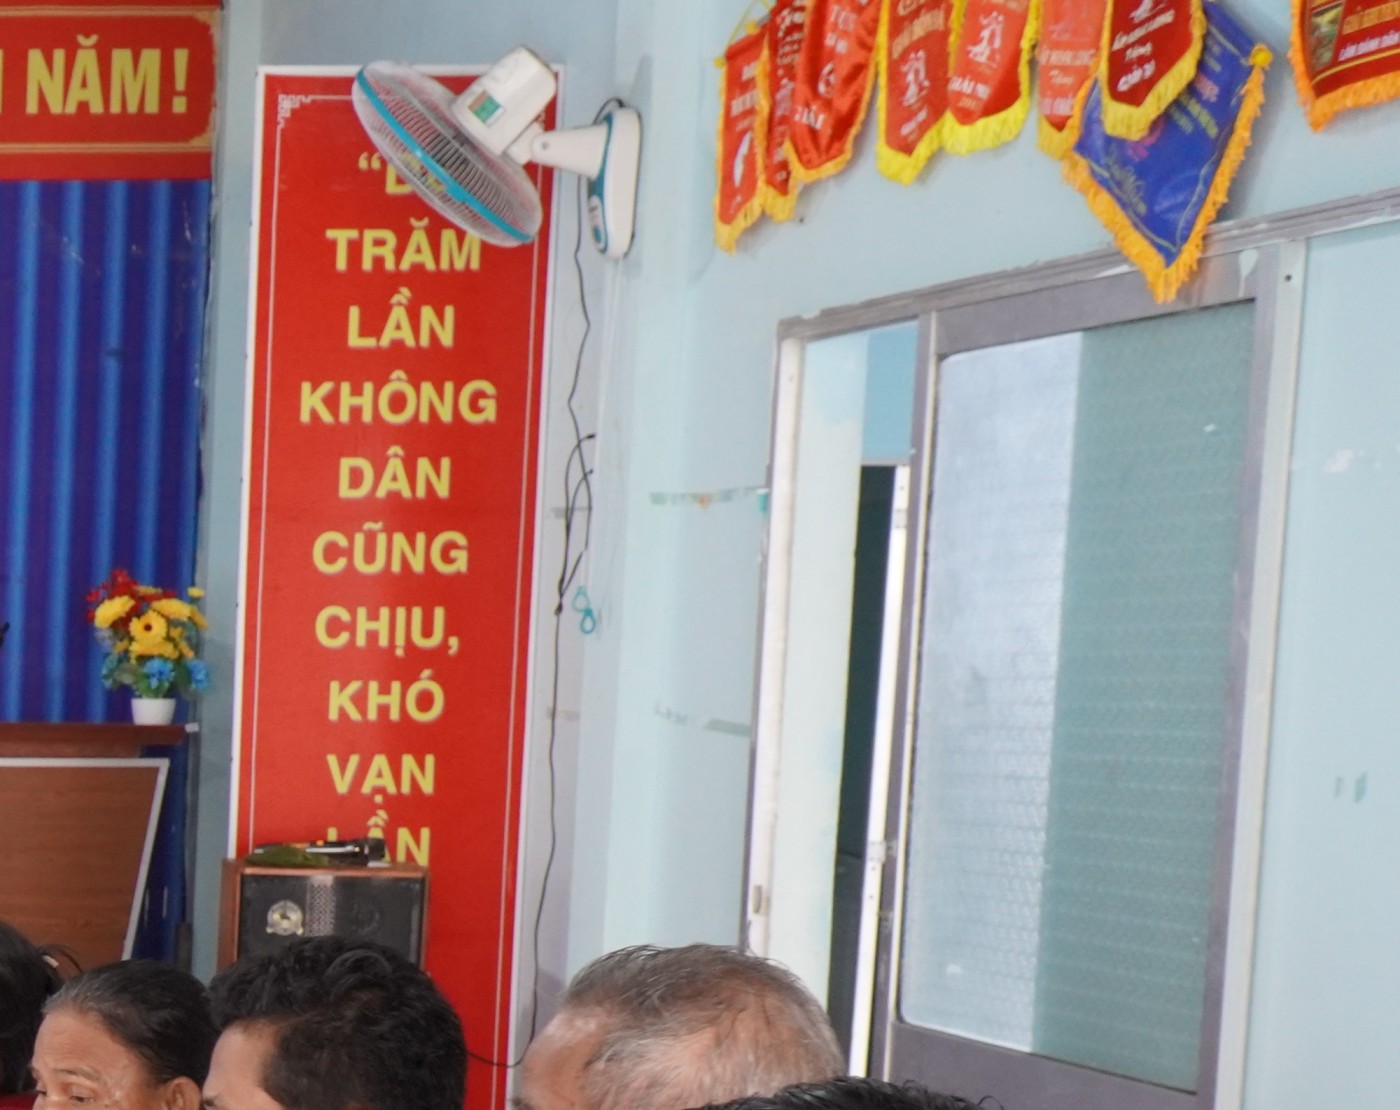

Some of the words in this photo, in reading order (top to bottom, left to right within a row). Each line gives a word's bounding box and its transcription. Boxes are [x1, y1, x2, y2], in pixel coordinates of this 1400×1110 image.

[326, 217, 481, 271] TRĂM
[347, 287, 454, 348] LẦN
[299, 369, 498, 424] KHÔNG
[338, 445, 451, 499] DÂN
[312, 521, 469, 575] CŨNG
[314, 605, 460, 656] CHỊU,
[328, 669, 445, 722] KHÓ
[326, 753, 436, 804] VẠN
